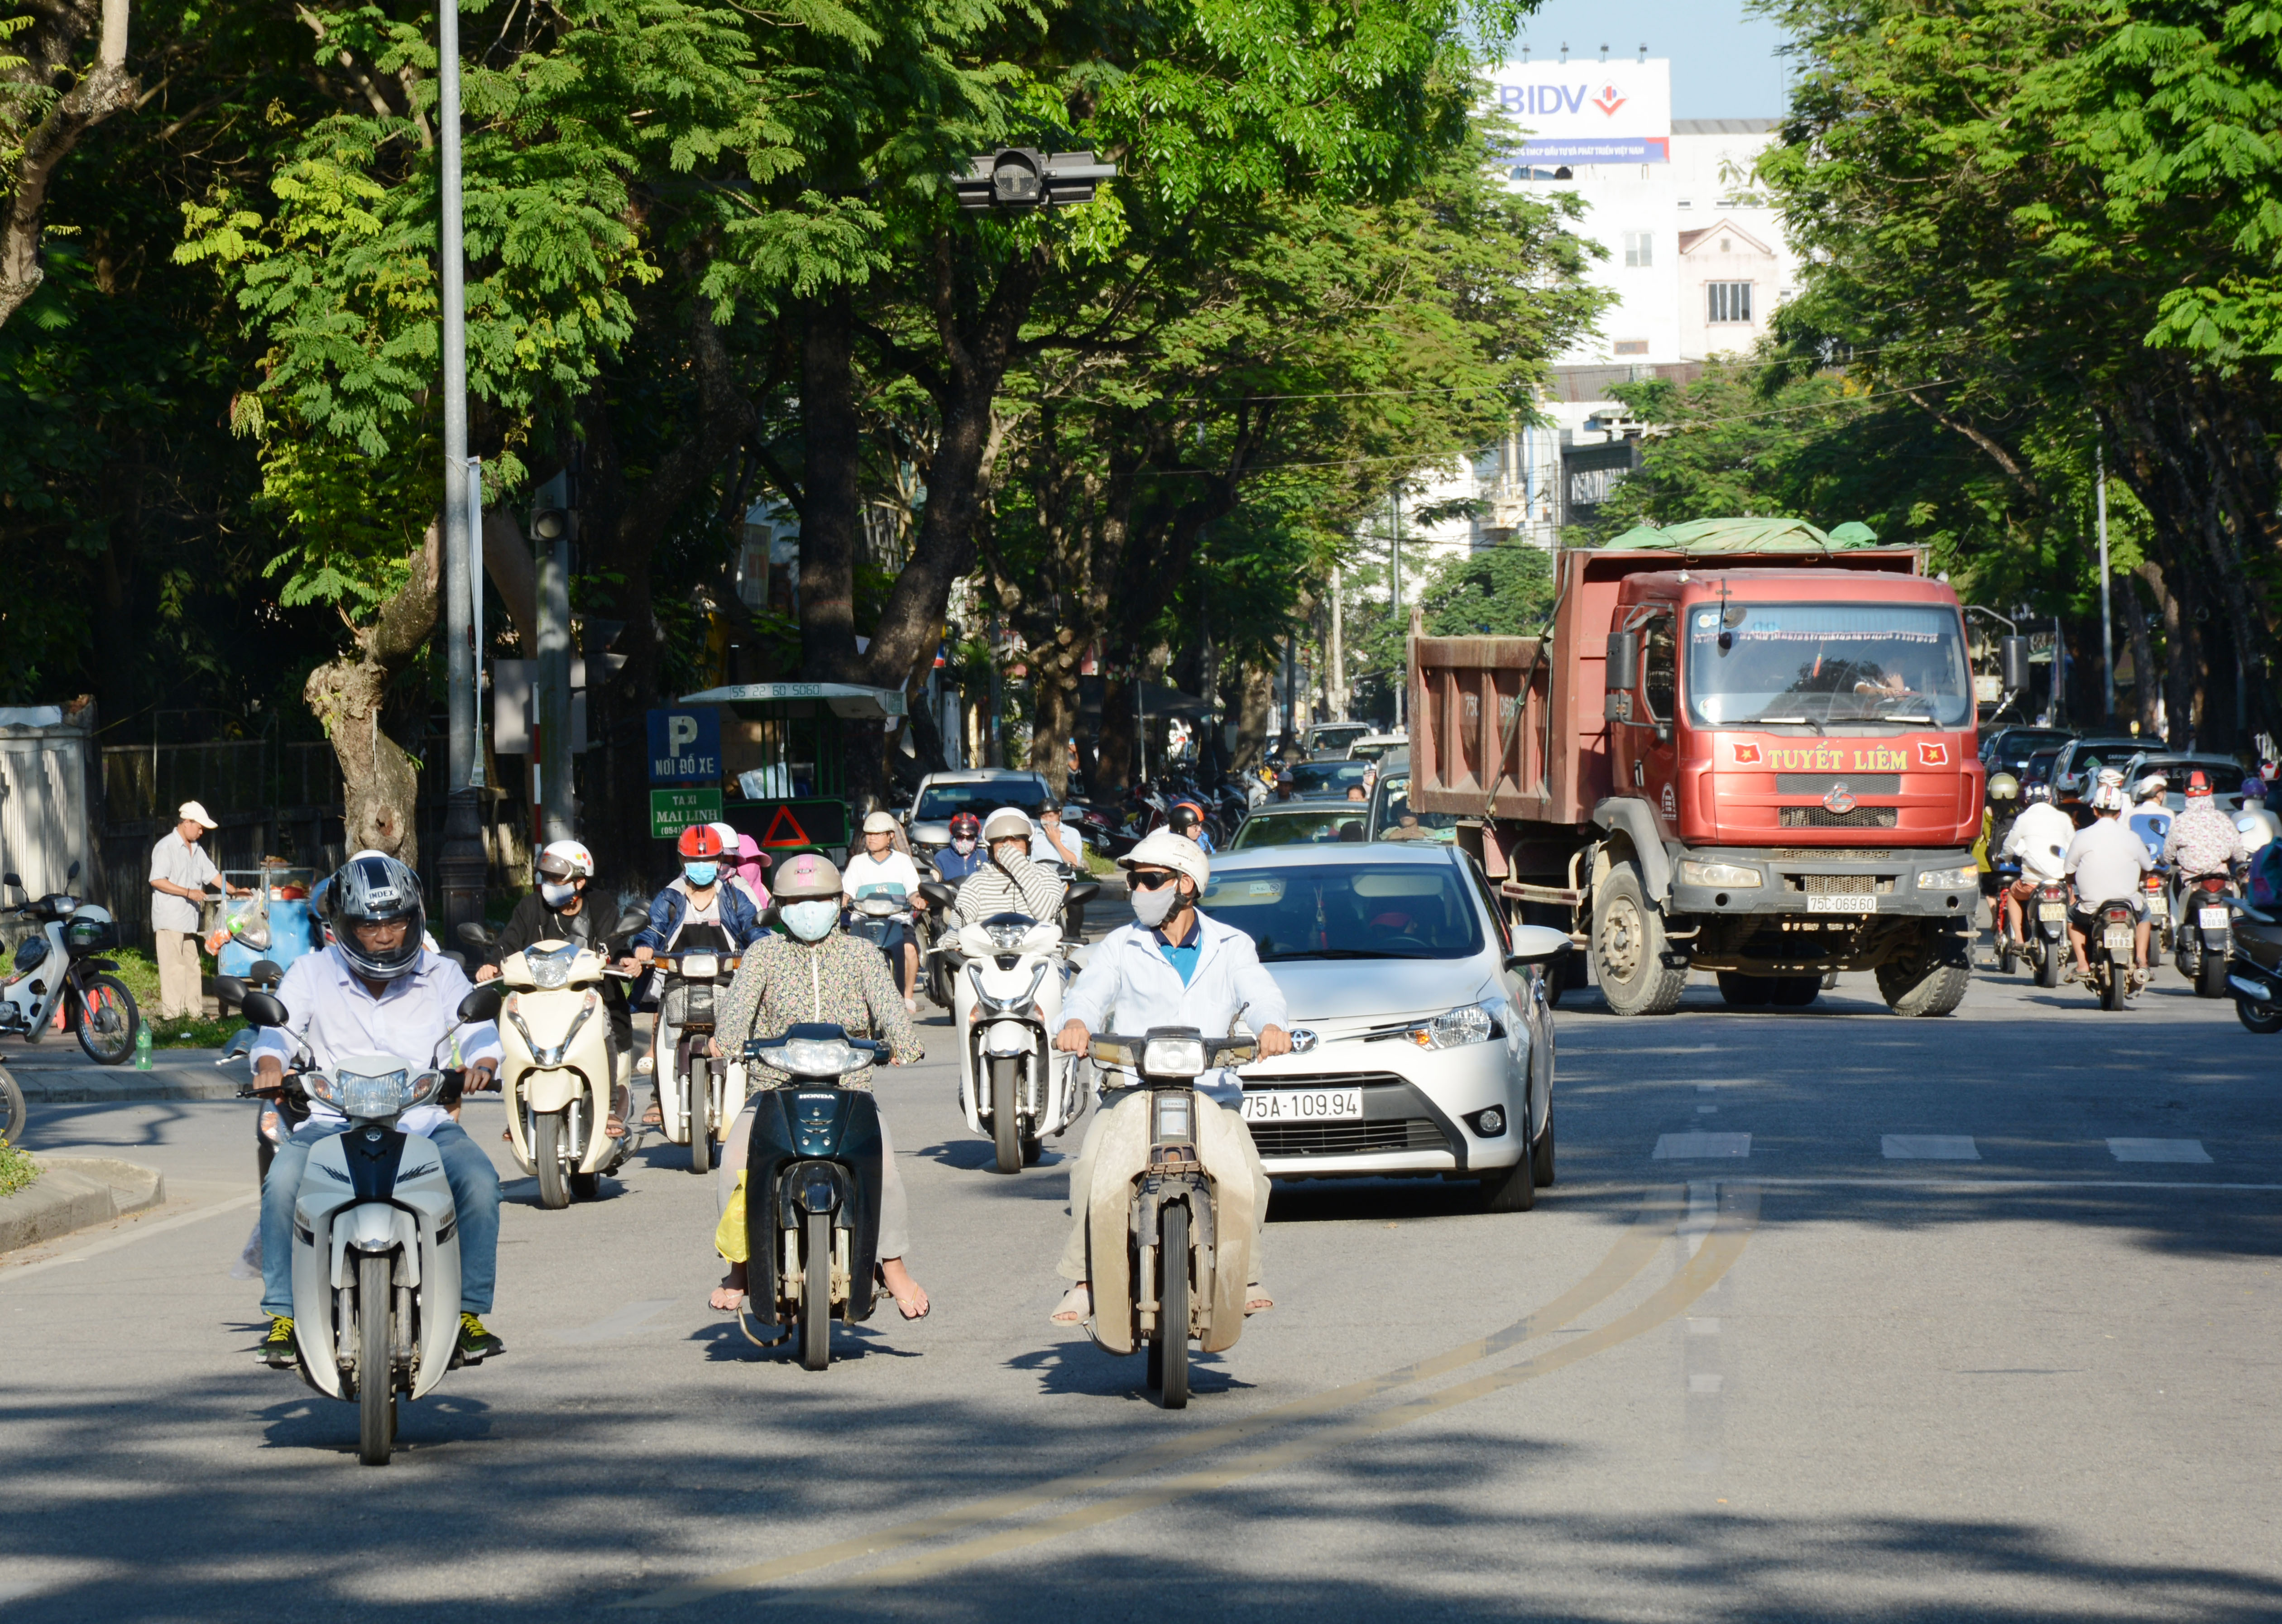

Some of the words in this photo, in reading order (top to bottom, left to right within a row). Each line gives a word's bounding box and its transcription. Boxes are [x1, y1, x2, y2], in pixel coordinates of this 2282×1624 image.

[1501, 85, 1587, 115] BIDV
[1629, 146, 1644, 155] NAM
[669, 716, 698, 757] P
[1767, 740, 1844, 770] TUYẾT
[1853, 744, 1908, 770] LIÊM
[655, 758, 675, 775] NƠI
[699, 757, 714, 774] XE
[657, 811, 682, 823] MAI
[686, 810, 718, 821] LINH
[369, 890, 394, 899] INDEX
[1811, 898, 1874, 910] 75C-069.60
[1244, 1093, 1357, 1118] 75A-109.94
